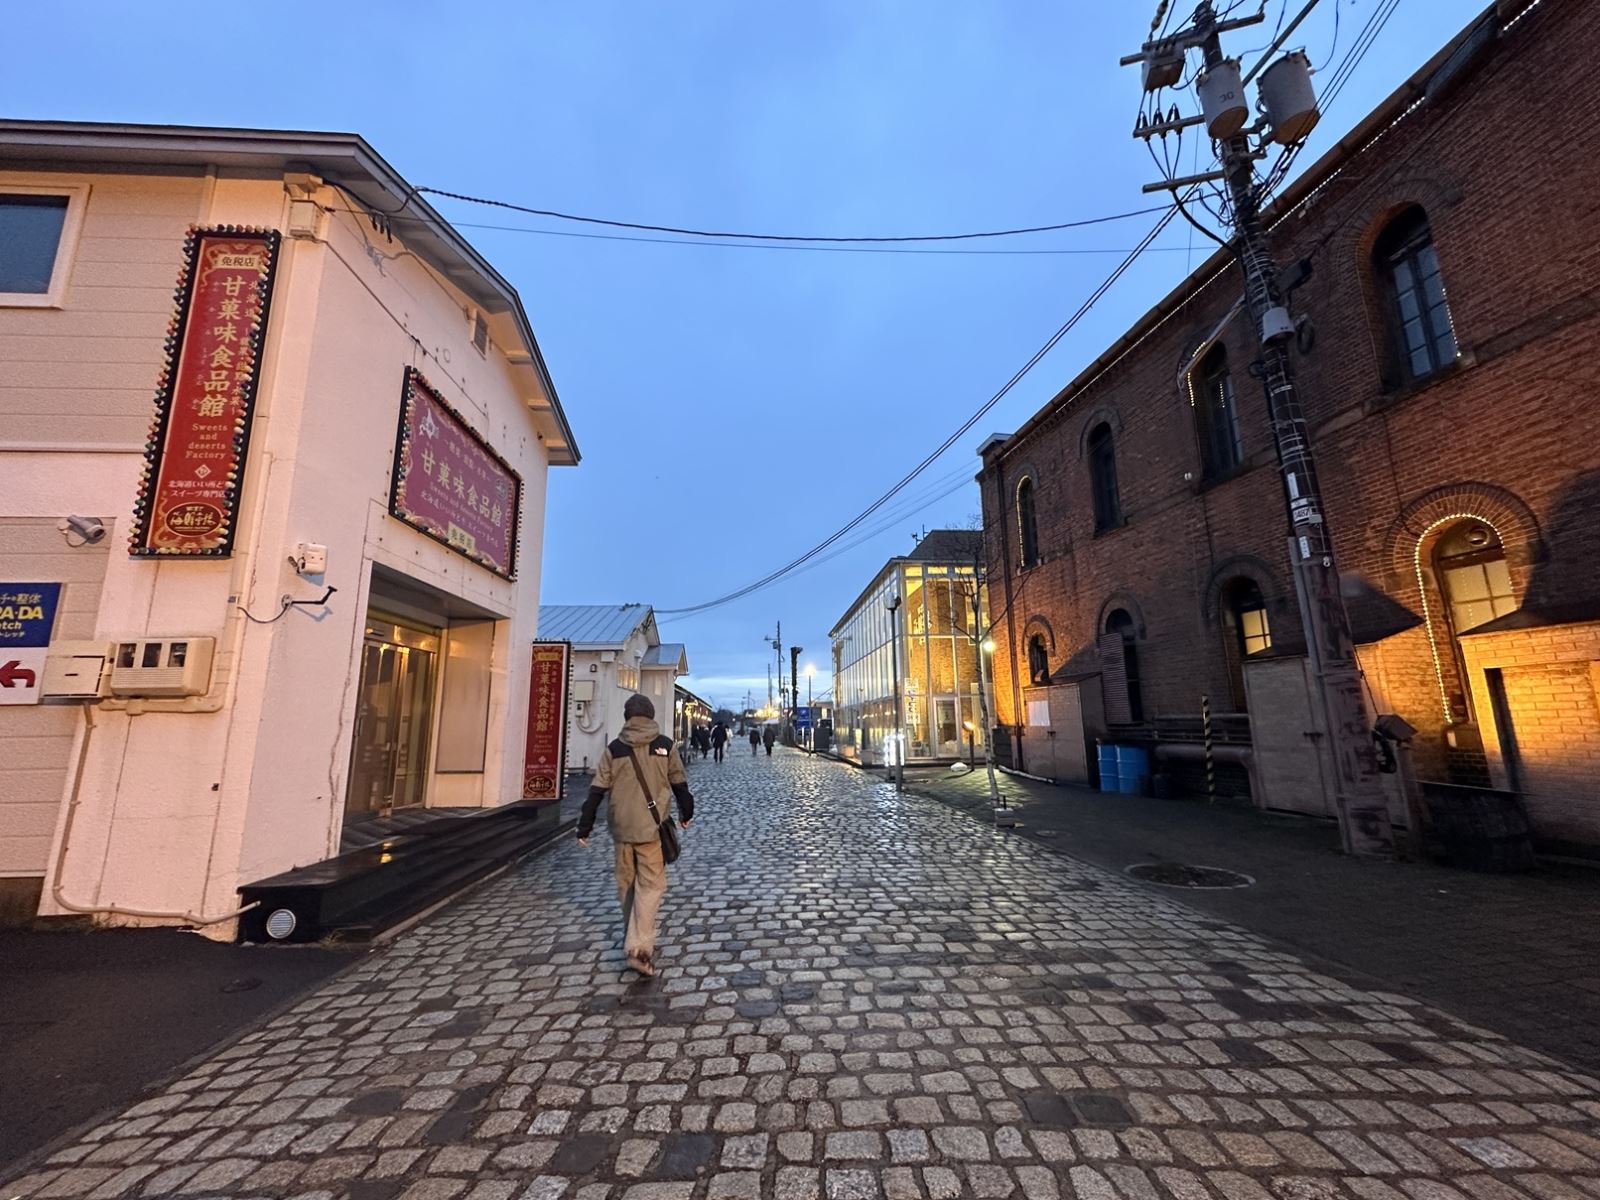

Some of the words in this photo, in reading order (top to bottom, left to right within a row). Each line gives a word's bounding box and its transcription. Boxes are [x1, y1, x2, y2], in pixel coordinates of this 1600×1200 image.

[222, 256, 256, 267] 免税店
[197, 275, 247, 417] 甘菓味食品館
[192, 423, 228, 431] Sweets
[188, 442, 226, 450] deserts
[185, 451, 226, 460] Factory
